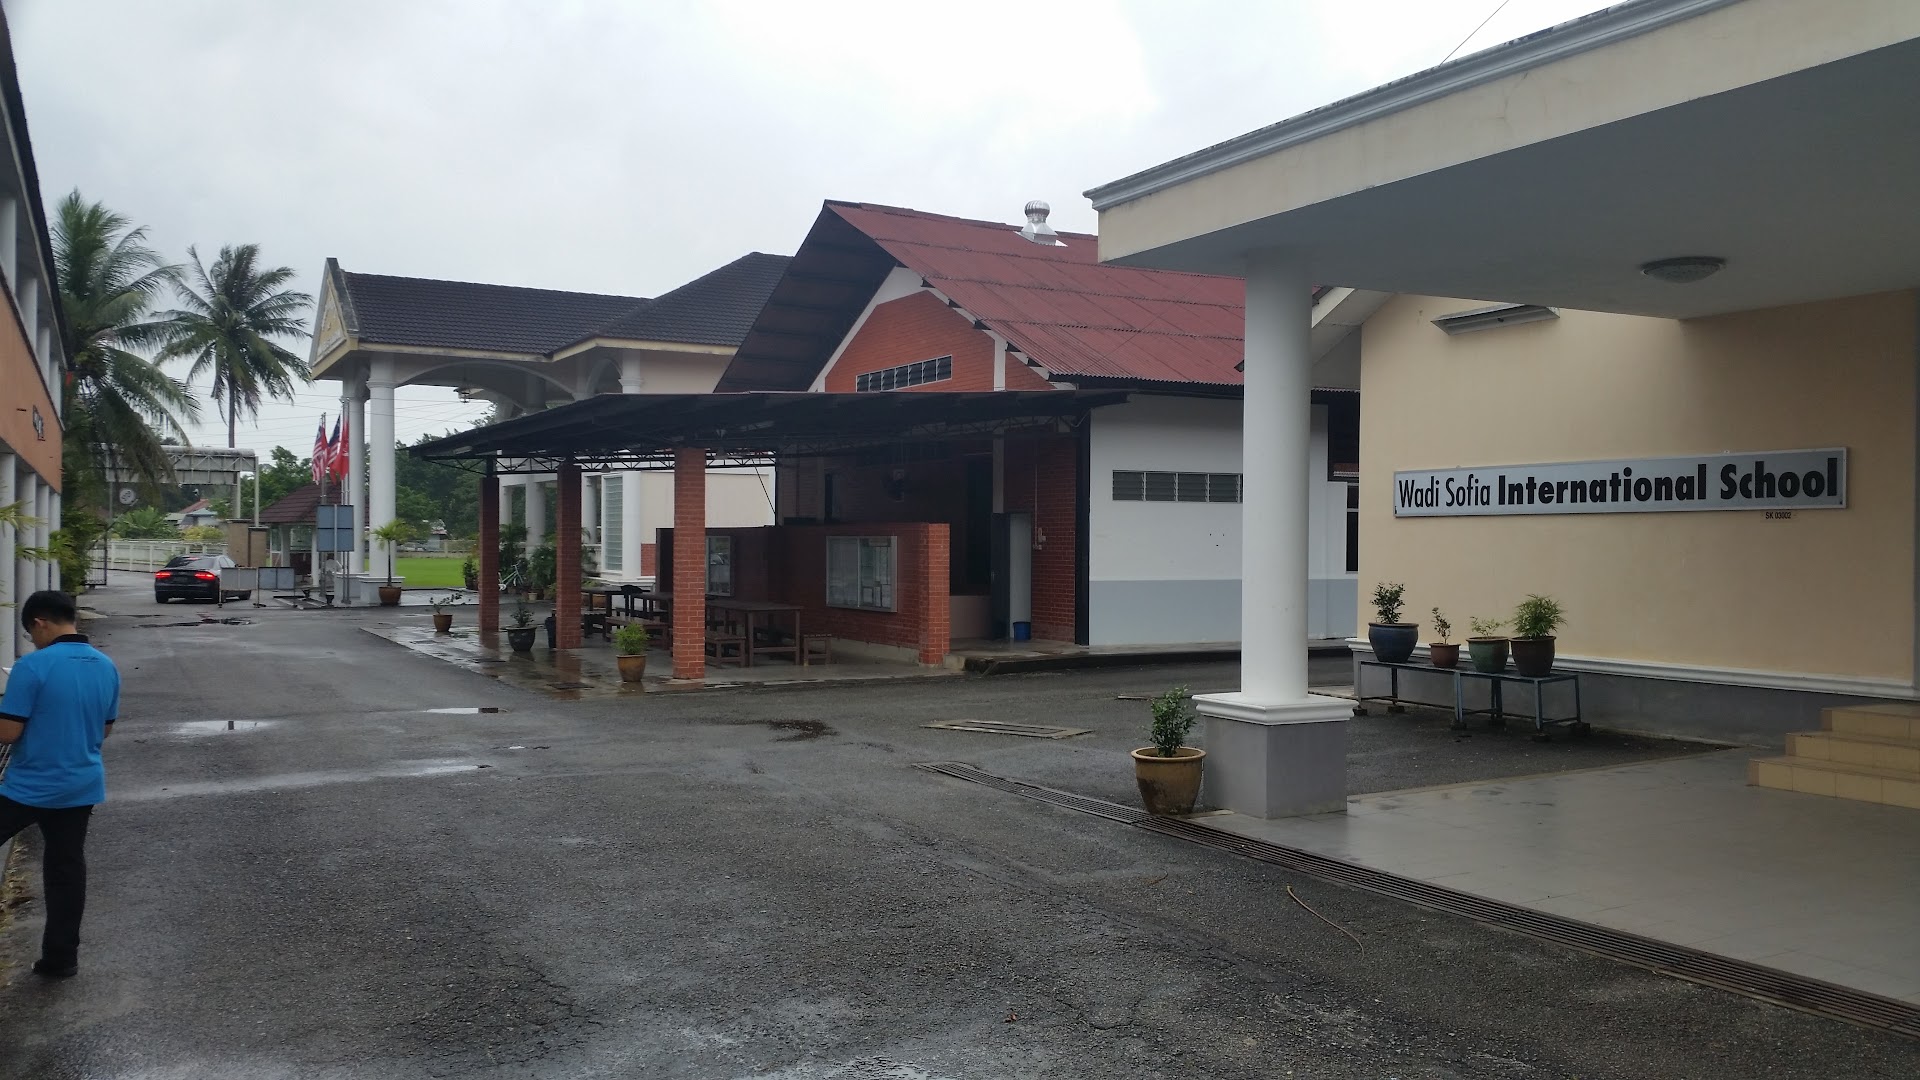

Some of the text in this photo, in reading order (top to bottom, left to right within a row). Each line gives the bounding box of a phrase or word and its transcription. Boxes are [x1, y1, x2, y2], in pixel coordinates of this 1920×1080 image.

[1398, 457, 1838, 507] Wadi Sofia International School
[1765, 511, 1774, 520] SK
